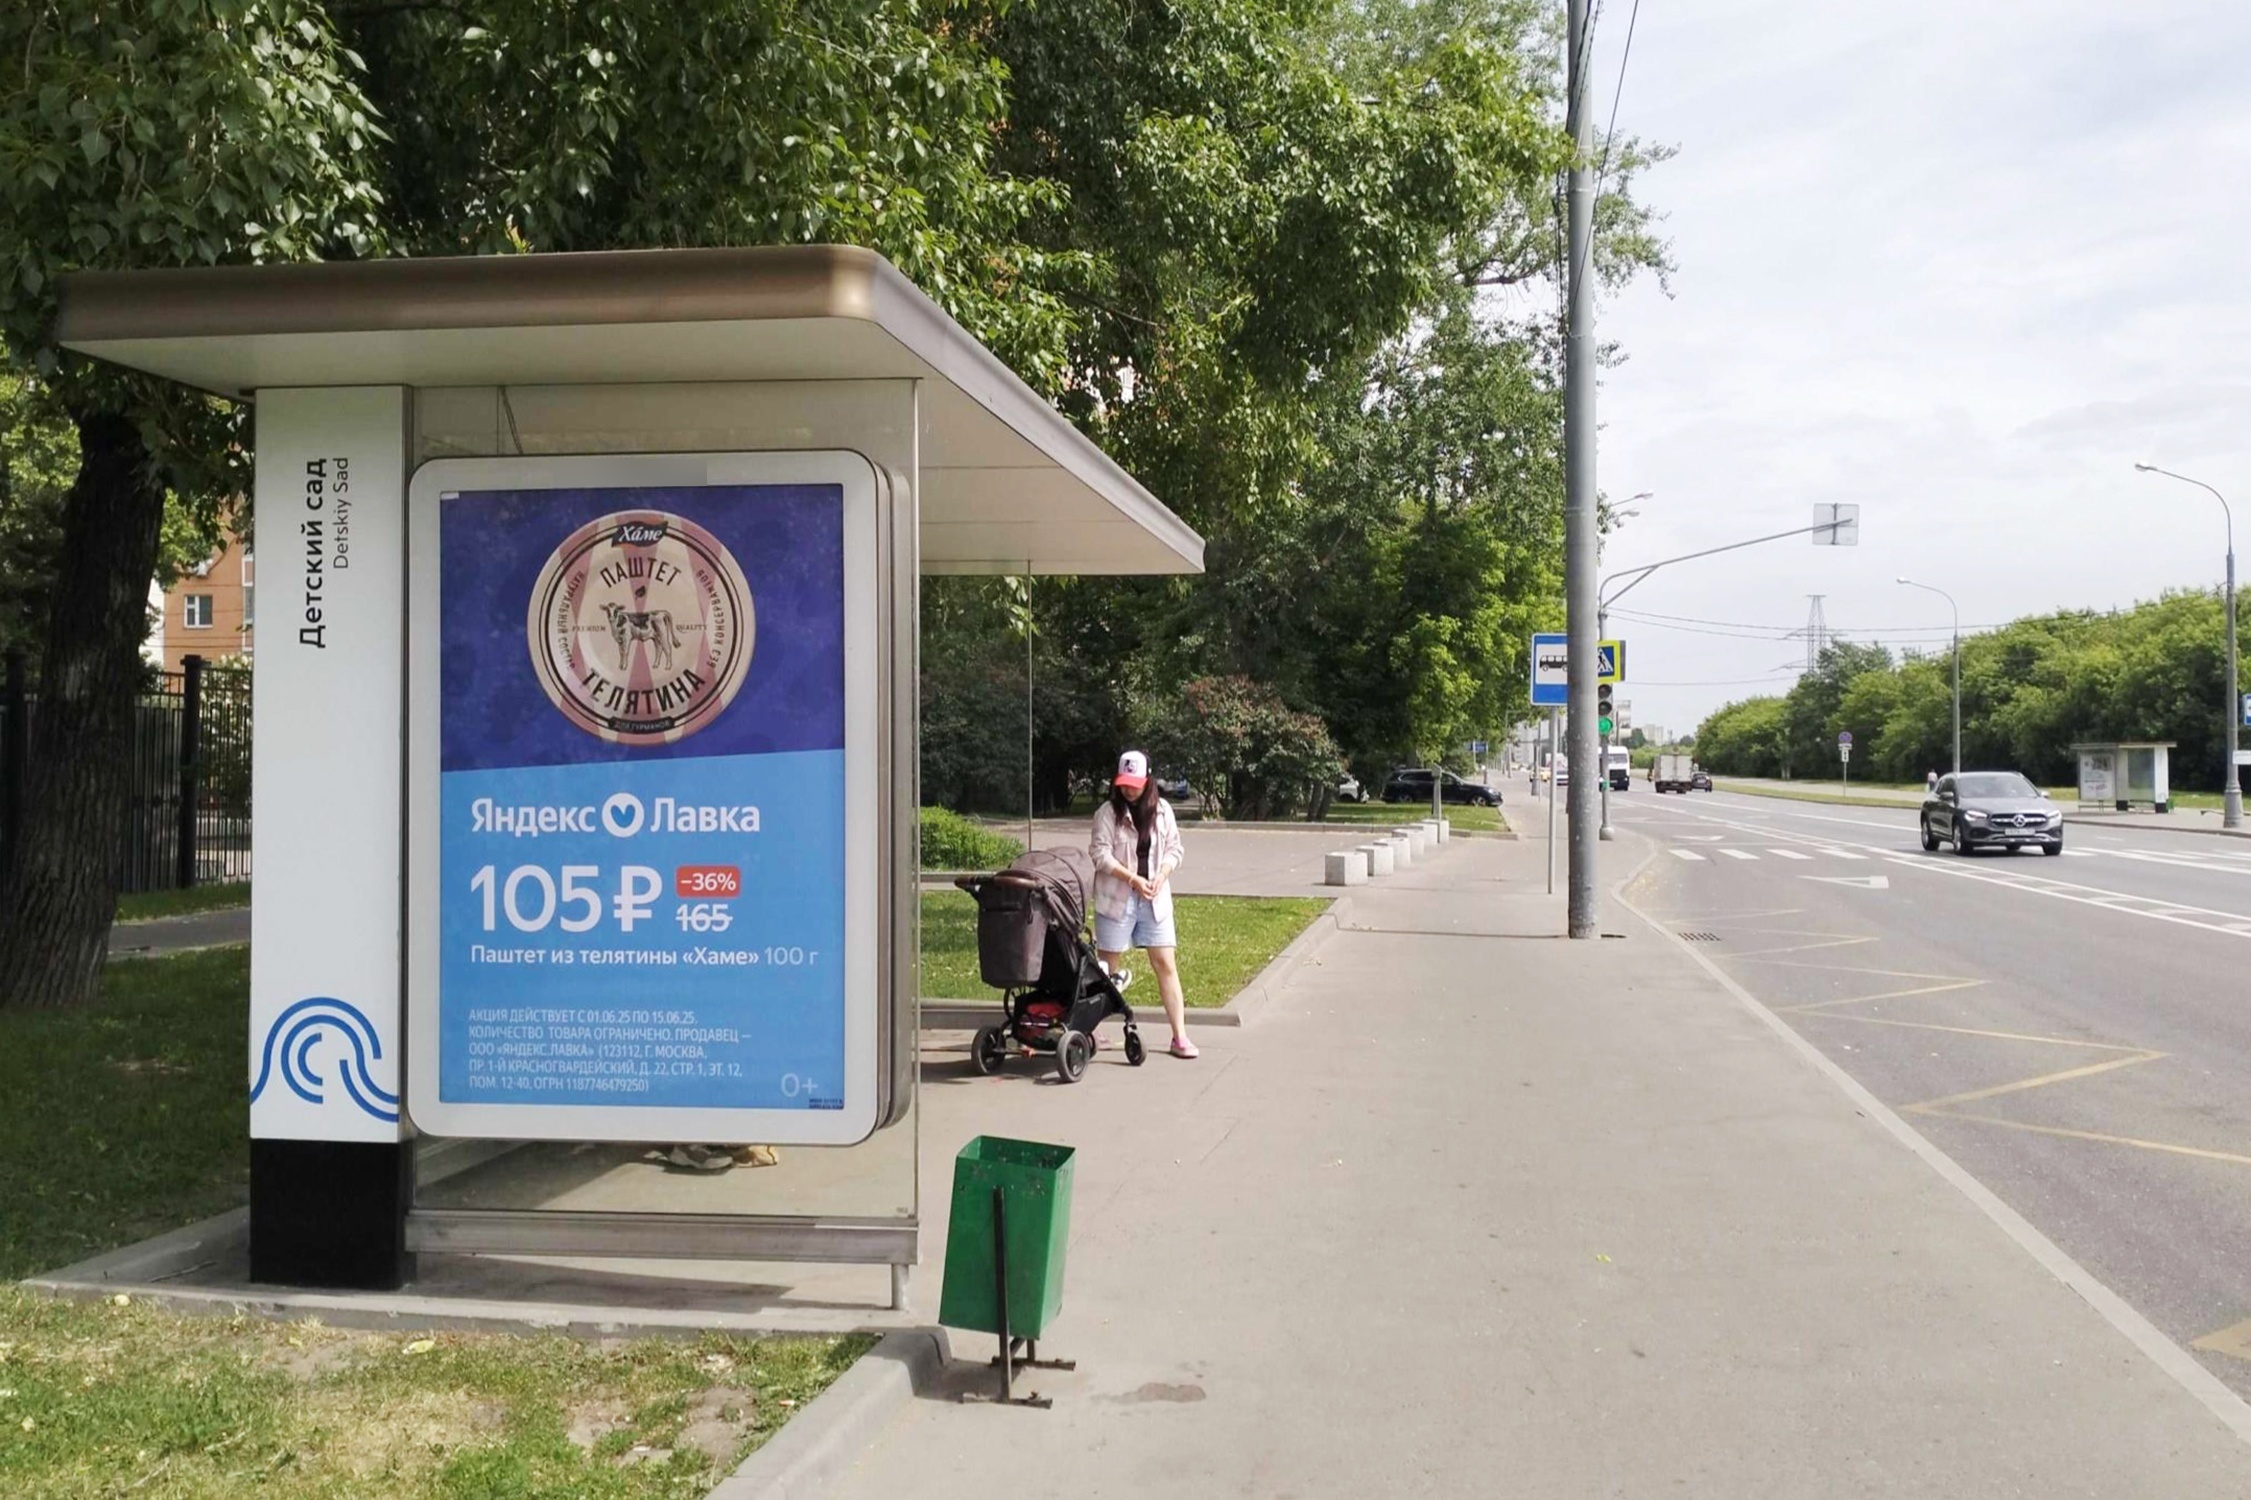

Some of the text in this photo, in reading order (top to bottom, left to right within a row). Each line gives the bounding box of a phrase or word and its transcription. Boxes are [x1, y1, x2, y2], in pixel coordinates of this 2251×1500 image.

[333, 457, 352, 569] Detskiy Sad
[300, 458, 327, 648] Детский сад
[600, 556, 682, 588] ПАШТЕТ
[581, 668, 706, 714] ТЕЛЯТИНА
[471, 798, 760, 838] Яндекс Лавка
[676, 903, 733, 932] 165
[471, 945, 818, 966] Паштет из телятины «Хаме» 100 г
[469, 1009, 508, 1024] АКЦИЯ
[510, 1006, 575, 1023] ДЕЙСТВУЕТ
[578, 1010, 585, 1023] С
[632, 1010, 649, 1023] ПО
[469, 1025, 543, 1039] КОЛИЧЕСТВО
[548, 1026, 591, 1040] ТОВАРА
[675, 1028, 739, 1043] ПРОДАВЕЦ
[469, 1042, 495, 1056] ООО
[534, 1077, 564, 1090] ОГРН
[781, 1072, 819, 1098] 0+
